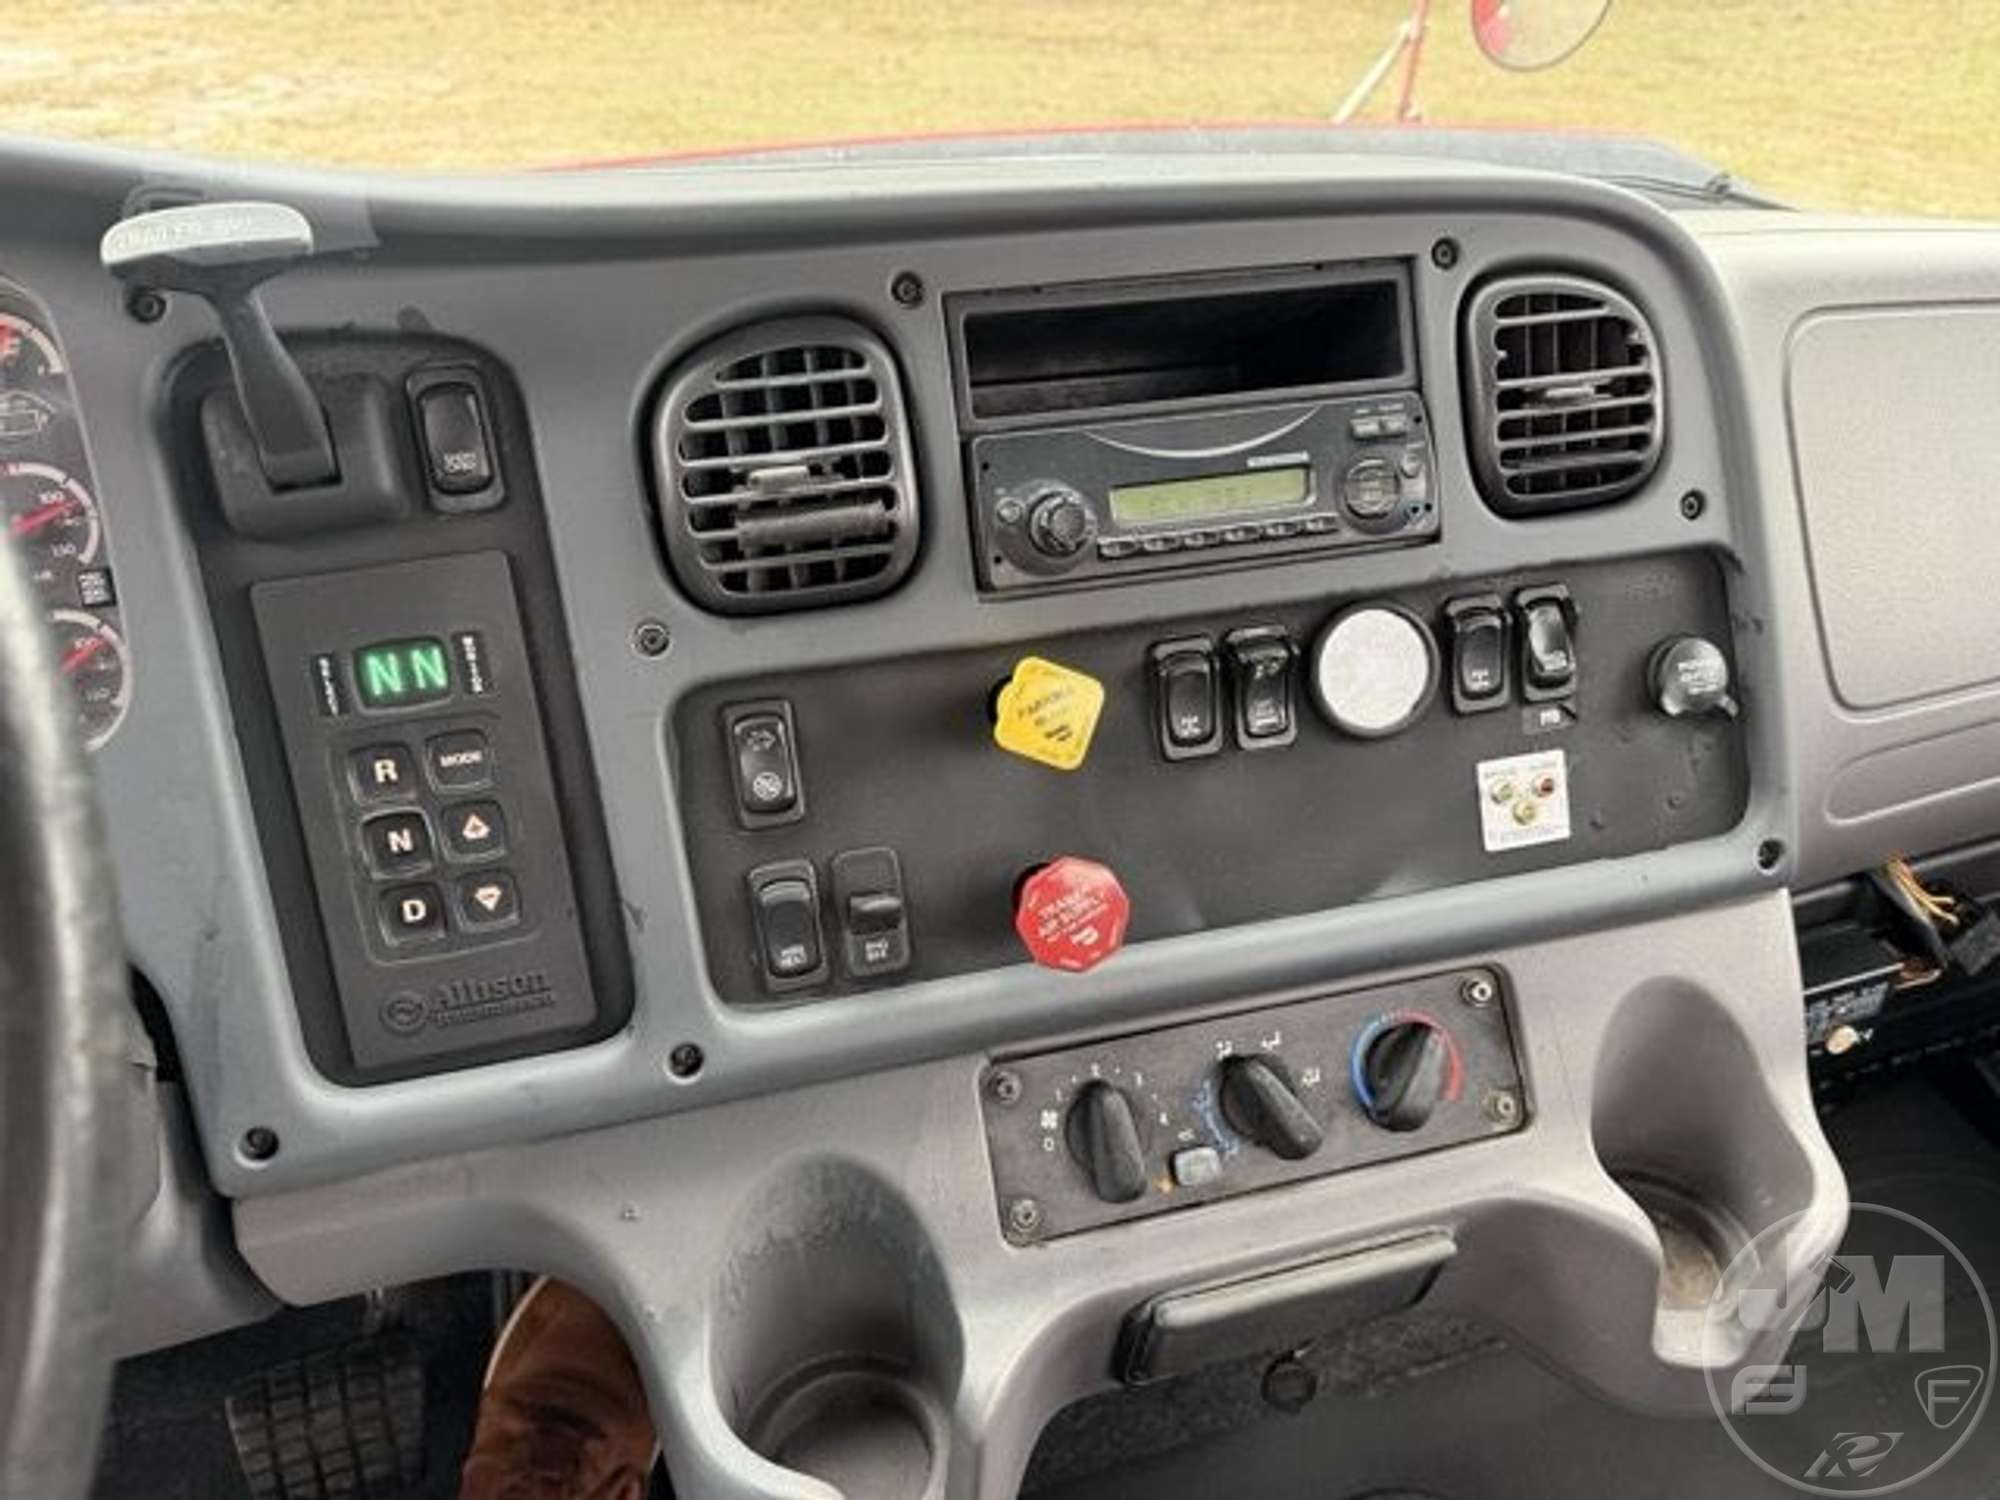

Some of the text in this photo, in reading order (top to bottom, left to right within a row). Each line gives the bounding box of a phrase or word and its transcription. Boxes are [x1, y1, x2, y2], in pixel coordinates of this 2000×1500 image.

[374, 759, 397, 782] R
[440, 751, 481, 767] MODE
[387, 828, 413, 853] N
[402, 900, 427, 924] D
